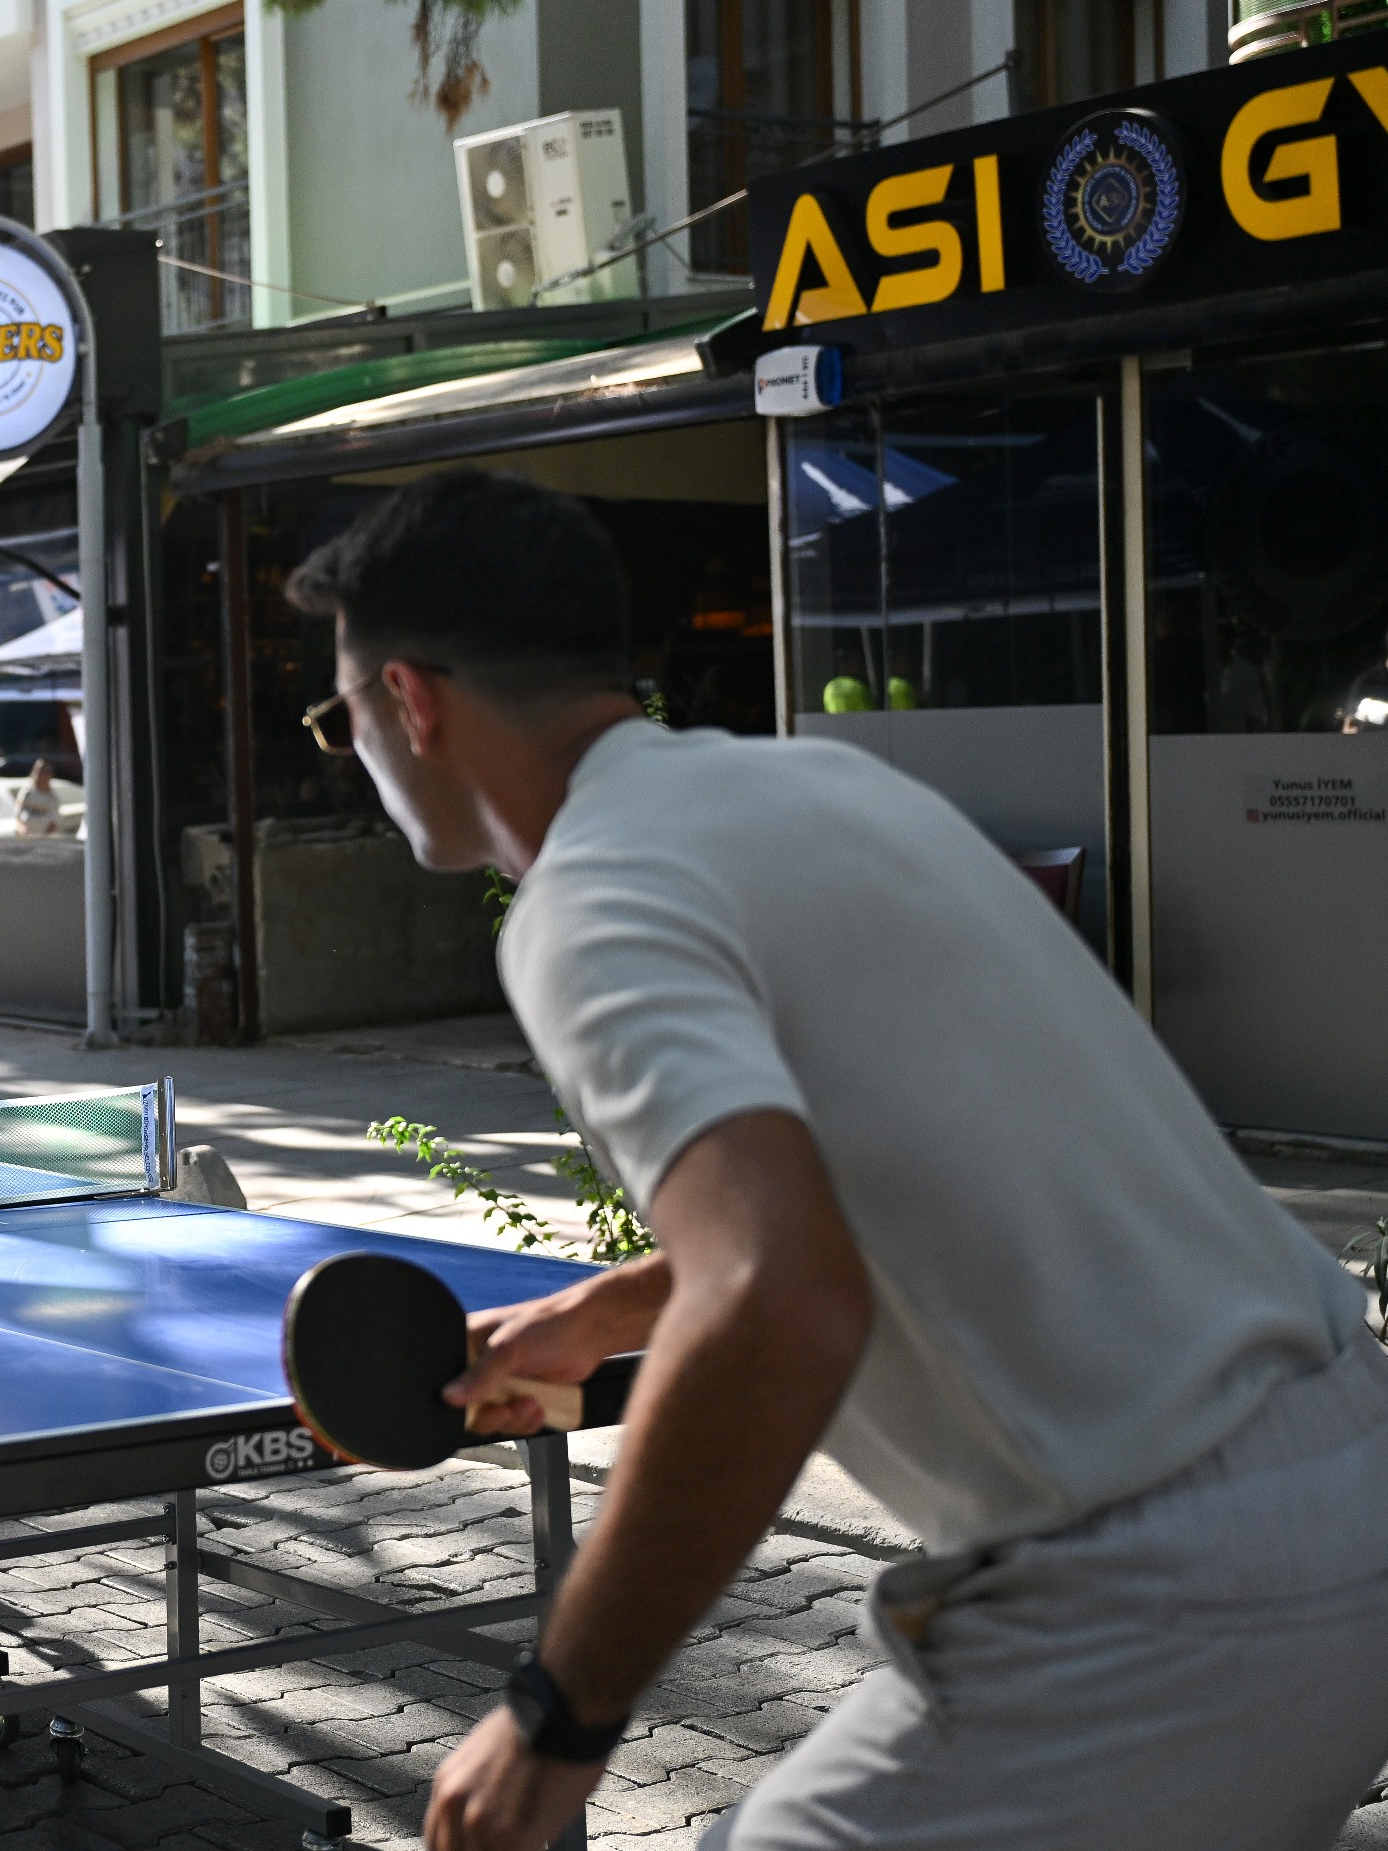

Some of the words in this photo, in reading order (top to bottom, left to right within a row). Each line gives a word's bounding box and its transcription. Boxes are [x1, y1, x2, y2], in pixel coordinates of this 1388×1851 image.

[761, 153, 1005, 333] ASI
[1272, 779, 1314, 791] Yunus
[1317, 776, 1353, 791] İYEM
[1269, 795, 1356, 807] 05557170701
[1262, 808, 1386, 823] yunusiyem.official
[236, 1427, 314, 1468] KBS
